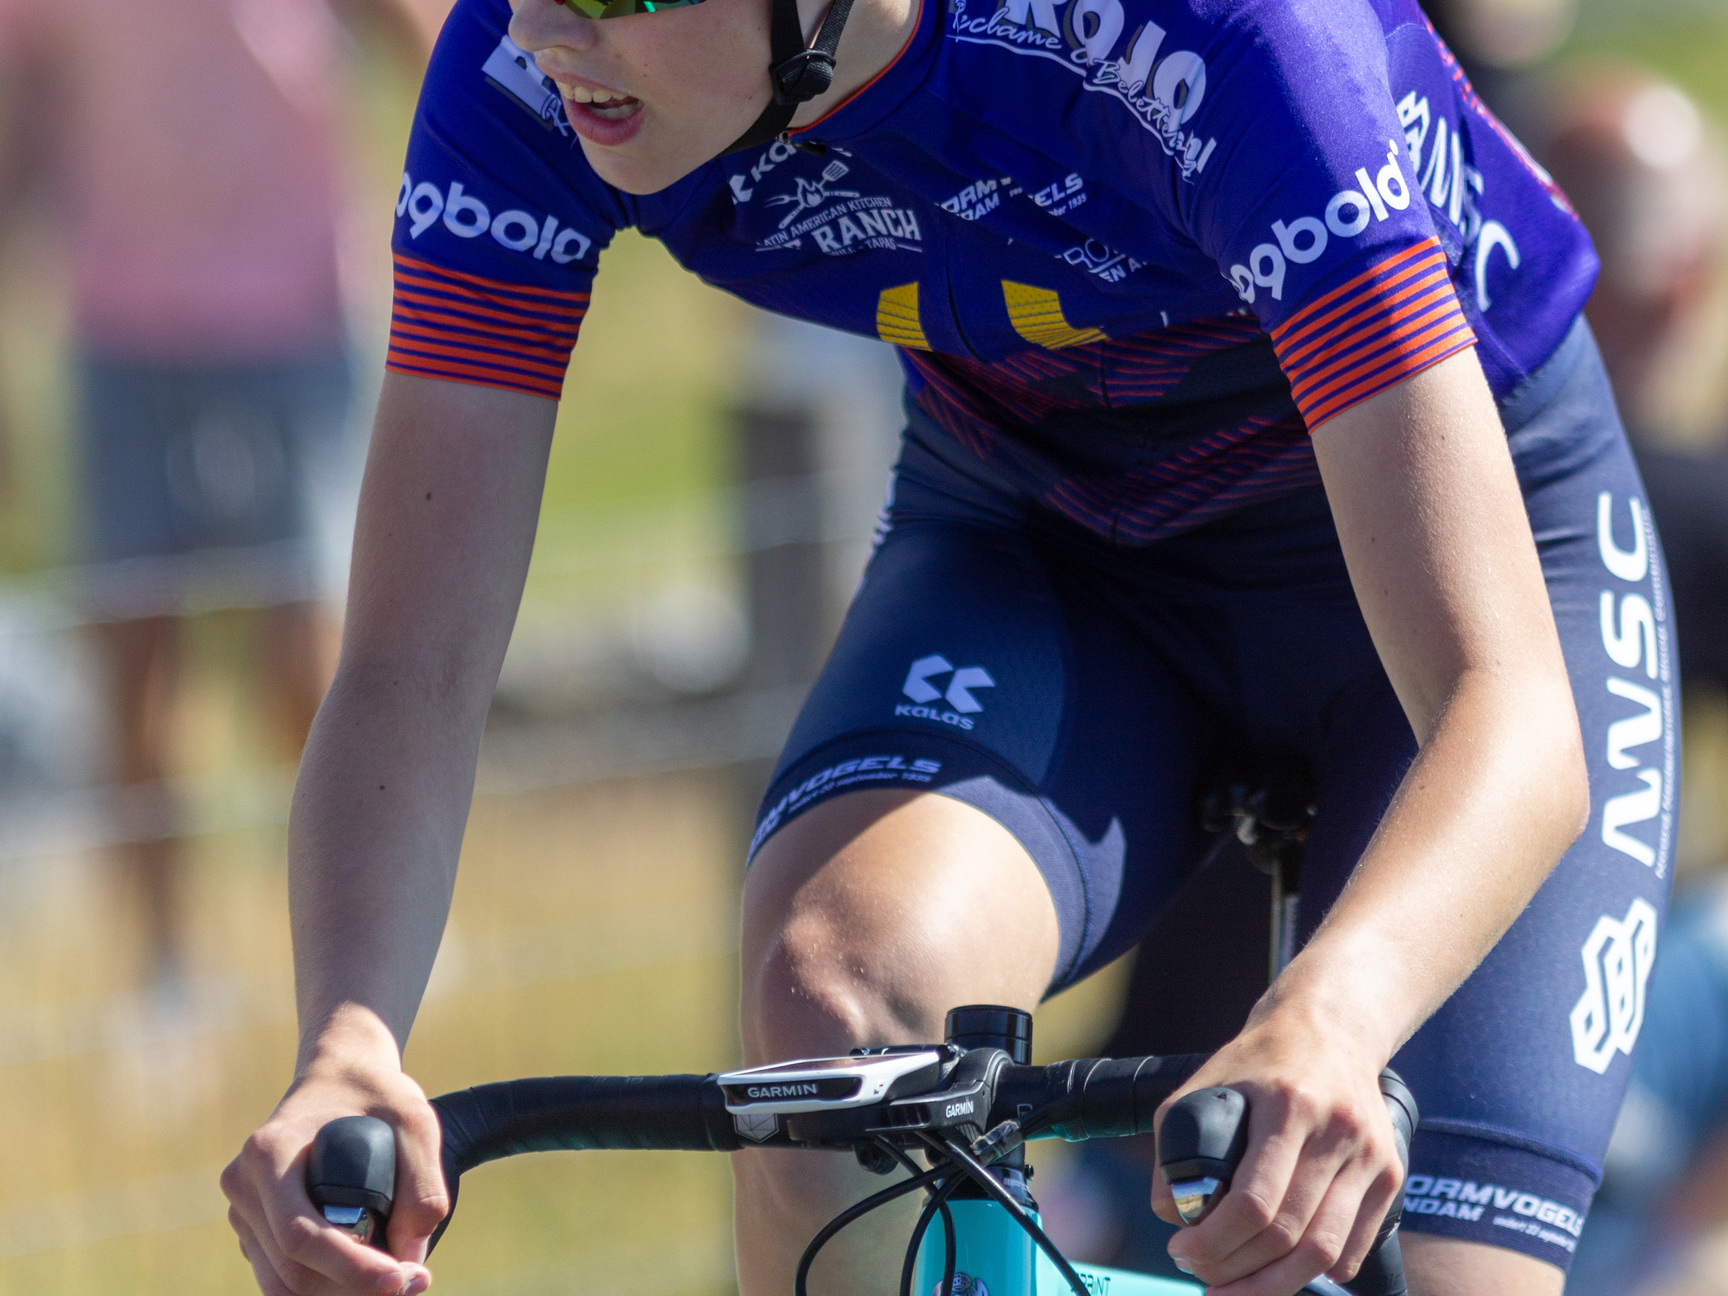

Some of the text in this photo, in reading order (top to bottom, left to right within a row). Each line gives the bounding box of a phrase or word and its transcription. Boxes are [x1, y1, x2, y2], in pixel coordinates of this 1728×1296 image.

[757, 230, 789, 247] ATIN
[790, 206, 847, 238] AMERICAN
[847, 197, 893, 212] KITCHEN
[811, 209, 922, 254] RANCH
[864, 237, 897, 251] TAPAS
[747, 1083, 818, 1099] GARMIN
[945, 1099, 975, 1119] GARMIN
